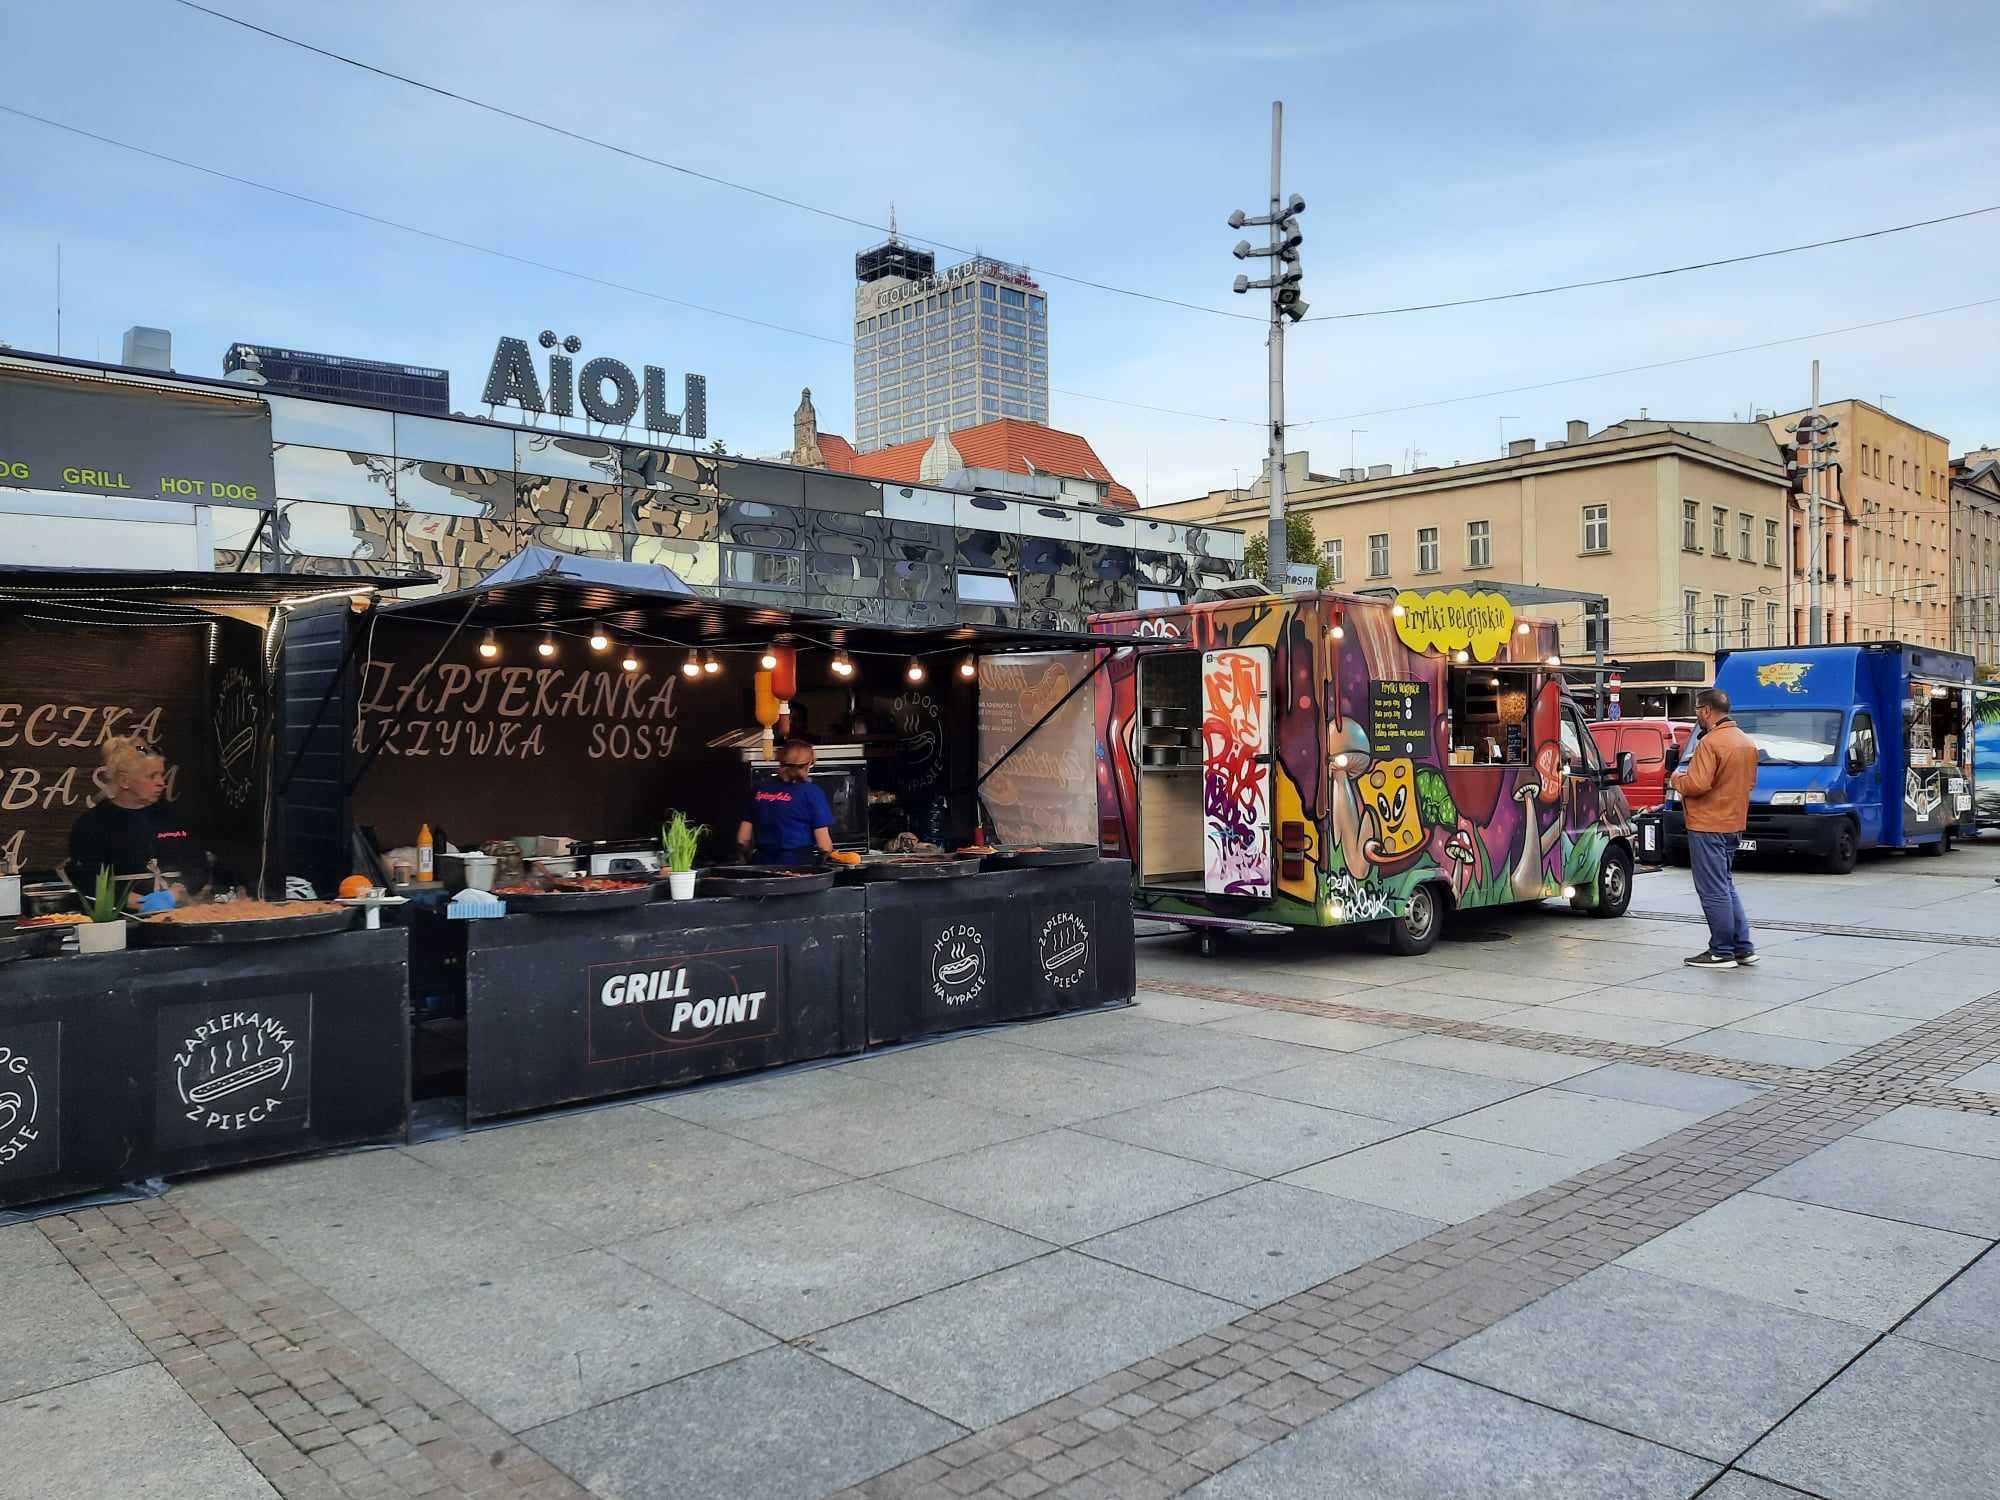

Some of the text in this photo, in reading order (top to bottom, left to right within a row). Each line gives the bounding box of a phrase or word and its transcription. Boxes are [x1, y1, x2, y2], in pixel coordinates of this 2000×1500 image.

[880, 262, 974, 308] COURTYARD
[62, 467, 131, 489] GRILL
[160, 477, 258, 501] HOT DOG
[1404, 605, 1505, 638] Frytki Belgijskie
[360, 660, 677, 719] ZAPIEKANKA
[588, 723, 678, 760] SOSY
[934, 924, 982, 952] HOT DOG
[1038, 912, 1090, 946] ZAPIEKANKA
[601, 967, 690, 1007] GRILL
[932, 976, 986, 1007] NA WYPASIE
[1044, 968, 1085, 989] Z PIECA
[670, 991, 766, 1033] POINT
[173, 1011, 296, 1068] ZAPIEKANKA
[186, 1096, 283, 1131] Z PIECA
[0, 1125, 39, 1166] SIE
